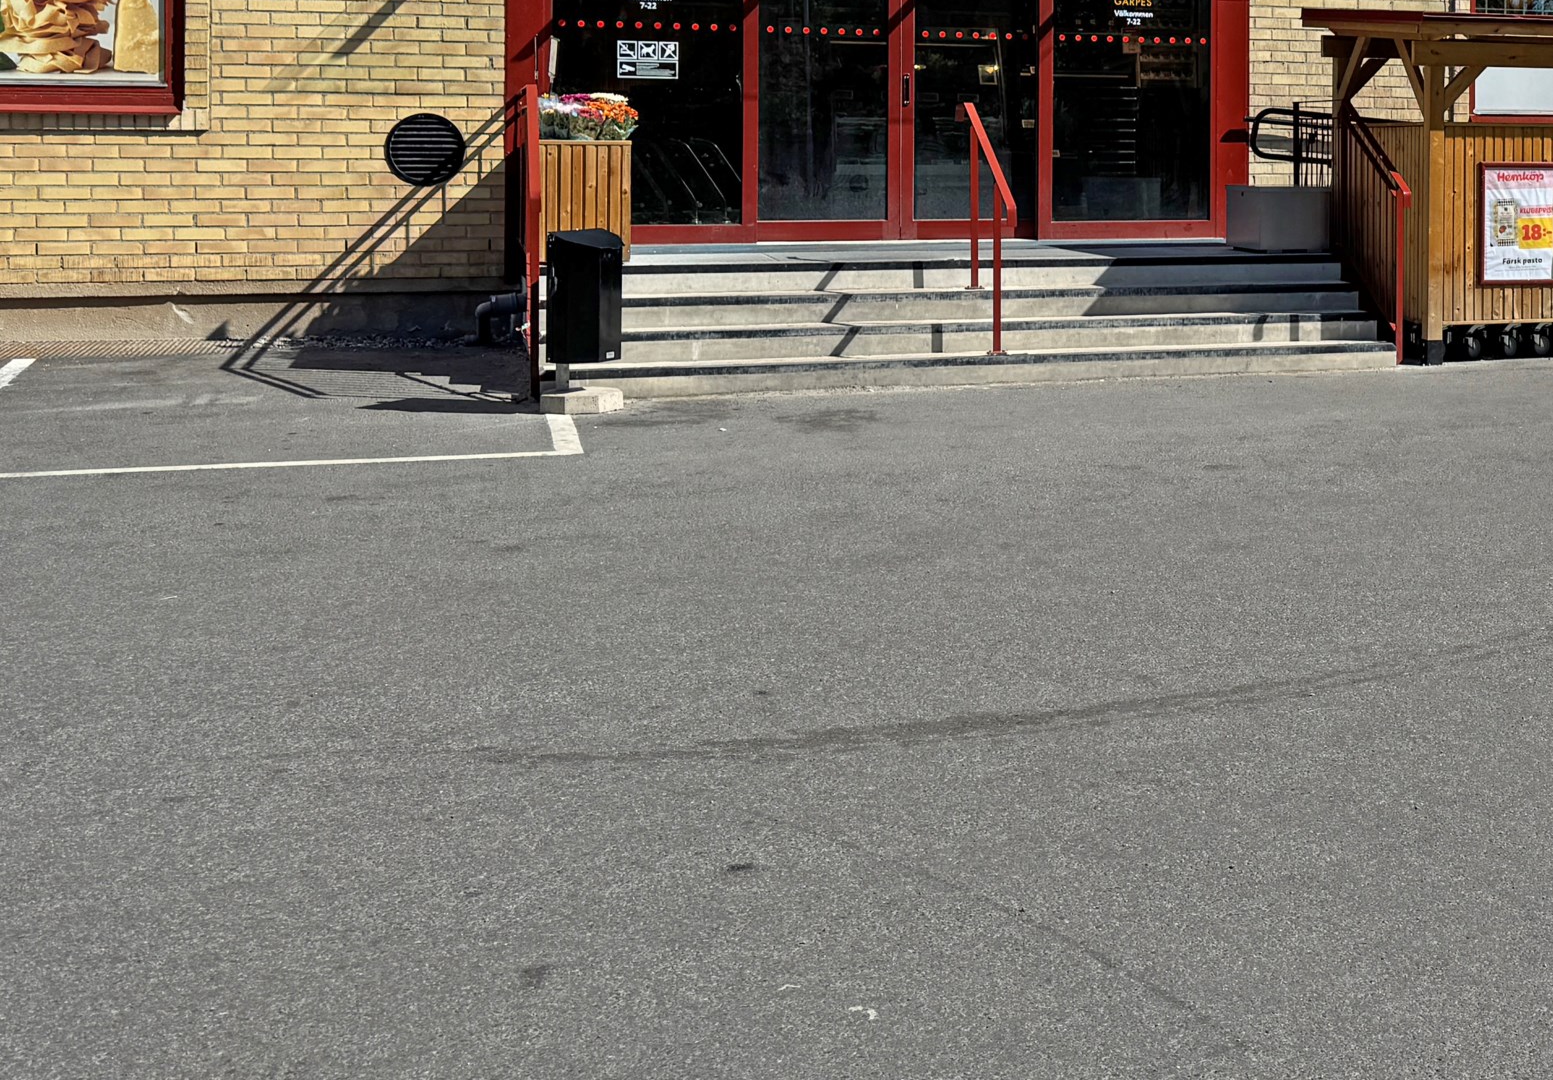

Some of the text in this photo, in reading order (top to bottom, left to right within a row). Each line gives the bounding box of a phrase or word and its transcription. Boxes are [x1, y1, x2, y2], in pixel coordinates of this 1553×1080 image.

[640, 2, 657, 10] 7-22
[1113, 9, 1153, 17] Välkommen
[1497, 170, 1545, 183] Hemköp
[1521, 224, 1553, 241] 18:-
[1502, 257, 1543, 266] Färsk pasta
